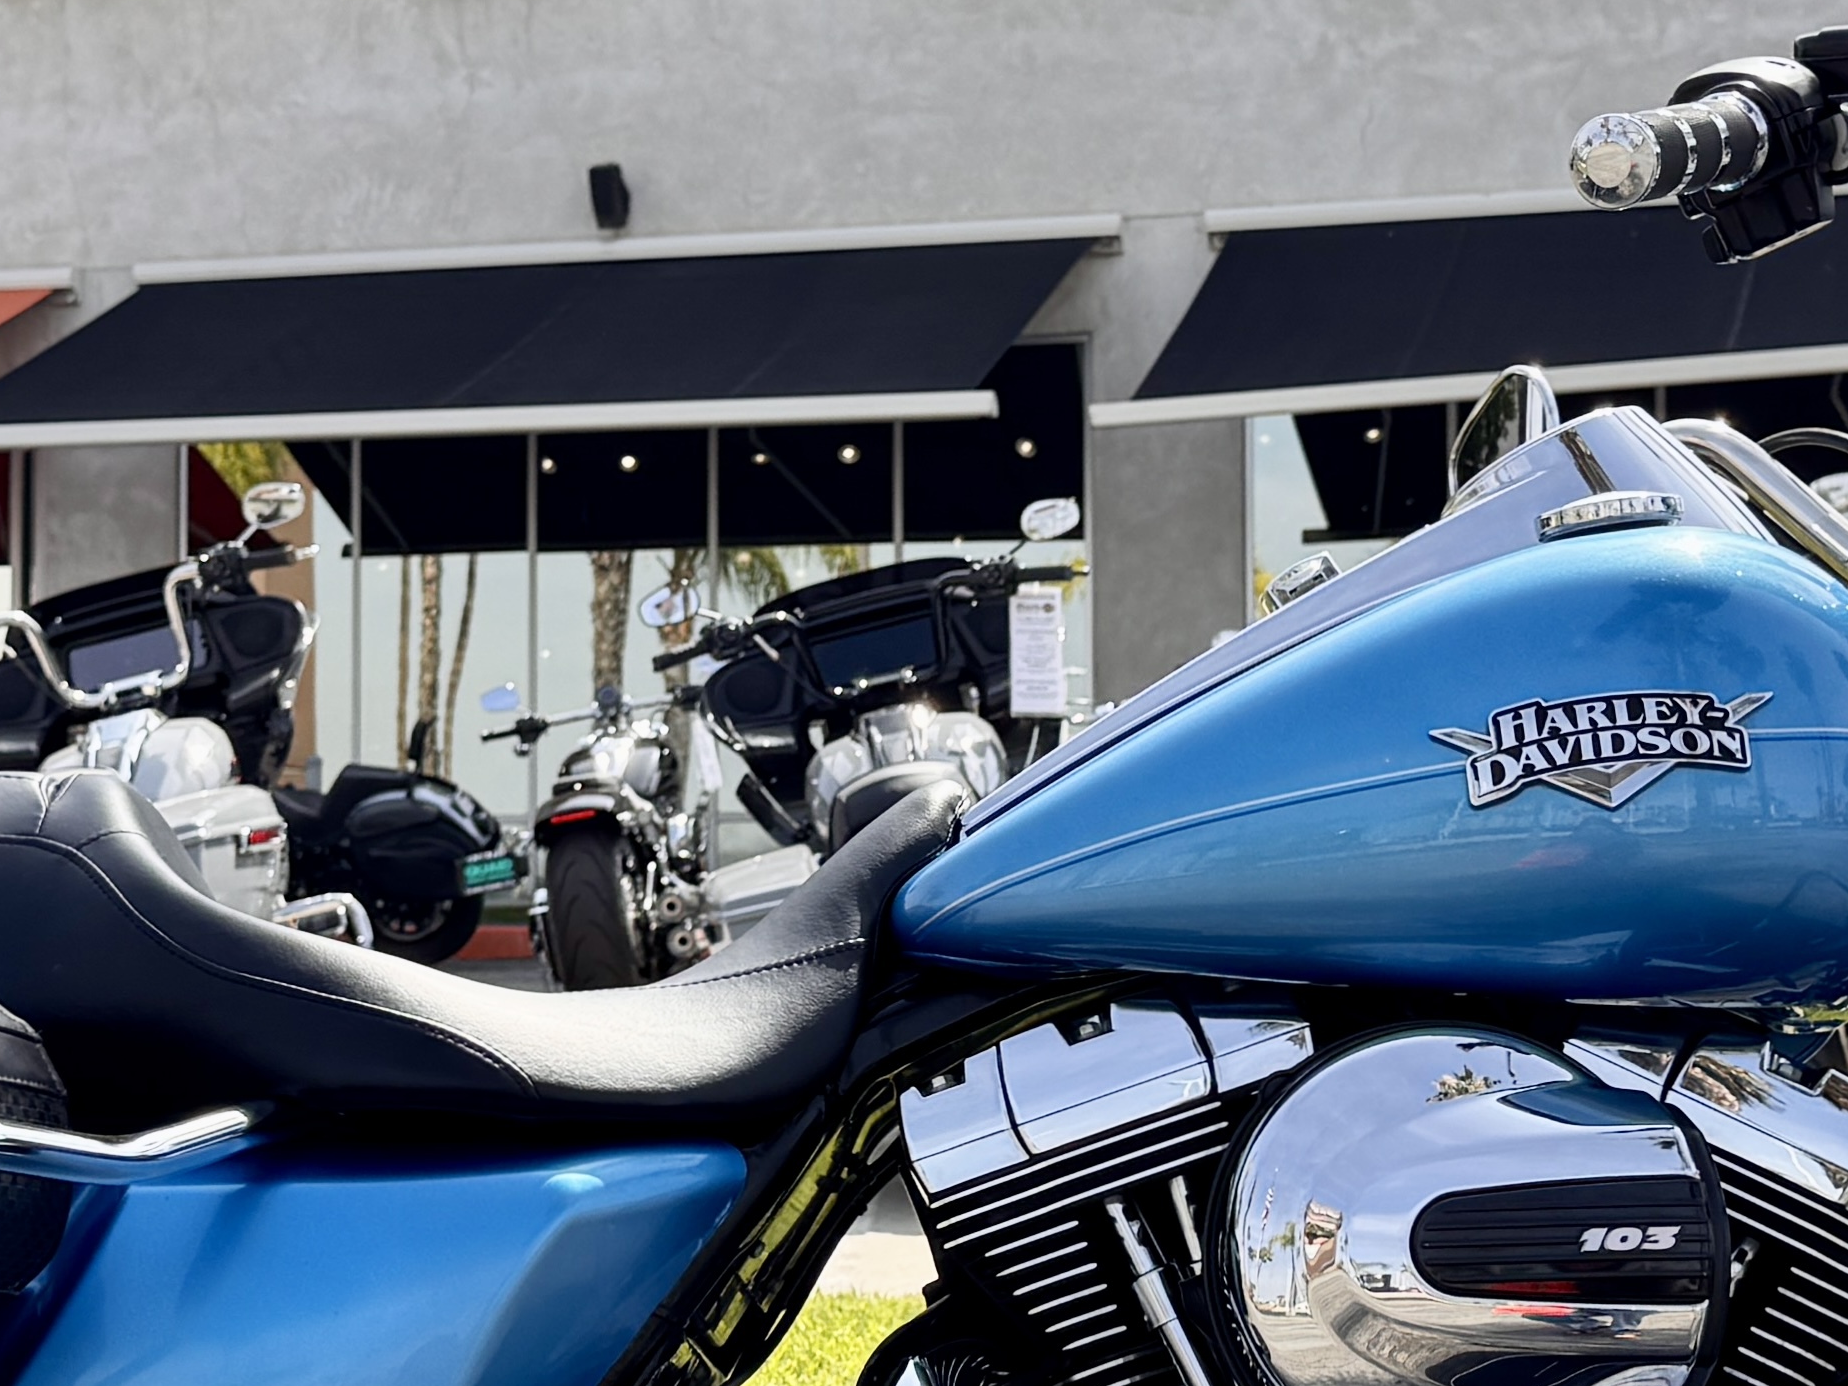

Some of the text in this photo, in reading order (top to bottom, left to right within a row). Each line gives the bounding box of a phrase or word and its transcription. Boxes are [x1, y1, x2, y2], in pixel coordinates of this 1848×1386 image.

[1496, 696, 1725, 750] HARLEY-
[1474, 726, 1745, 798] DAVIDSON
[1578, 1225, 1682, 1253] 103
